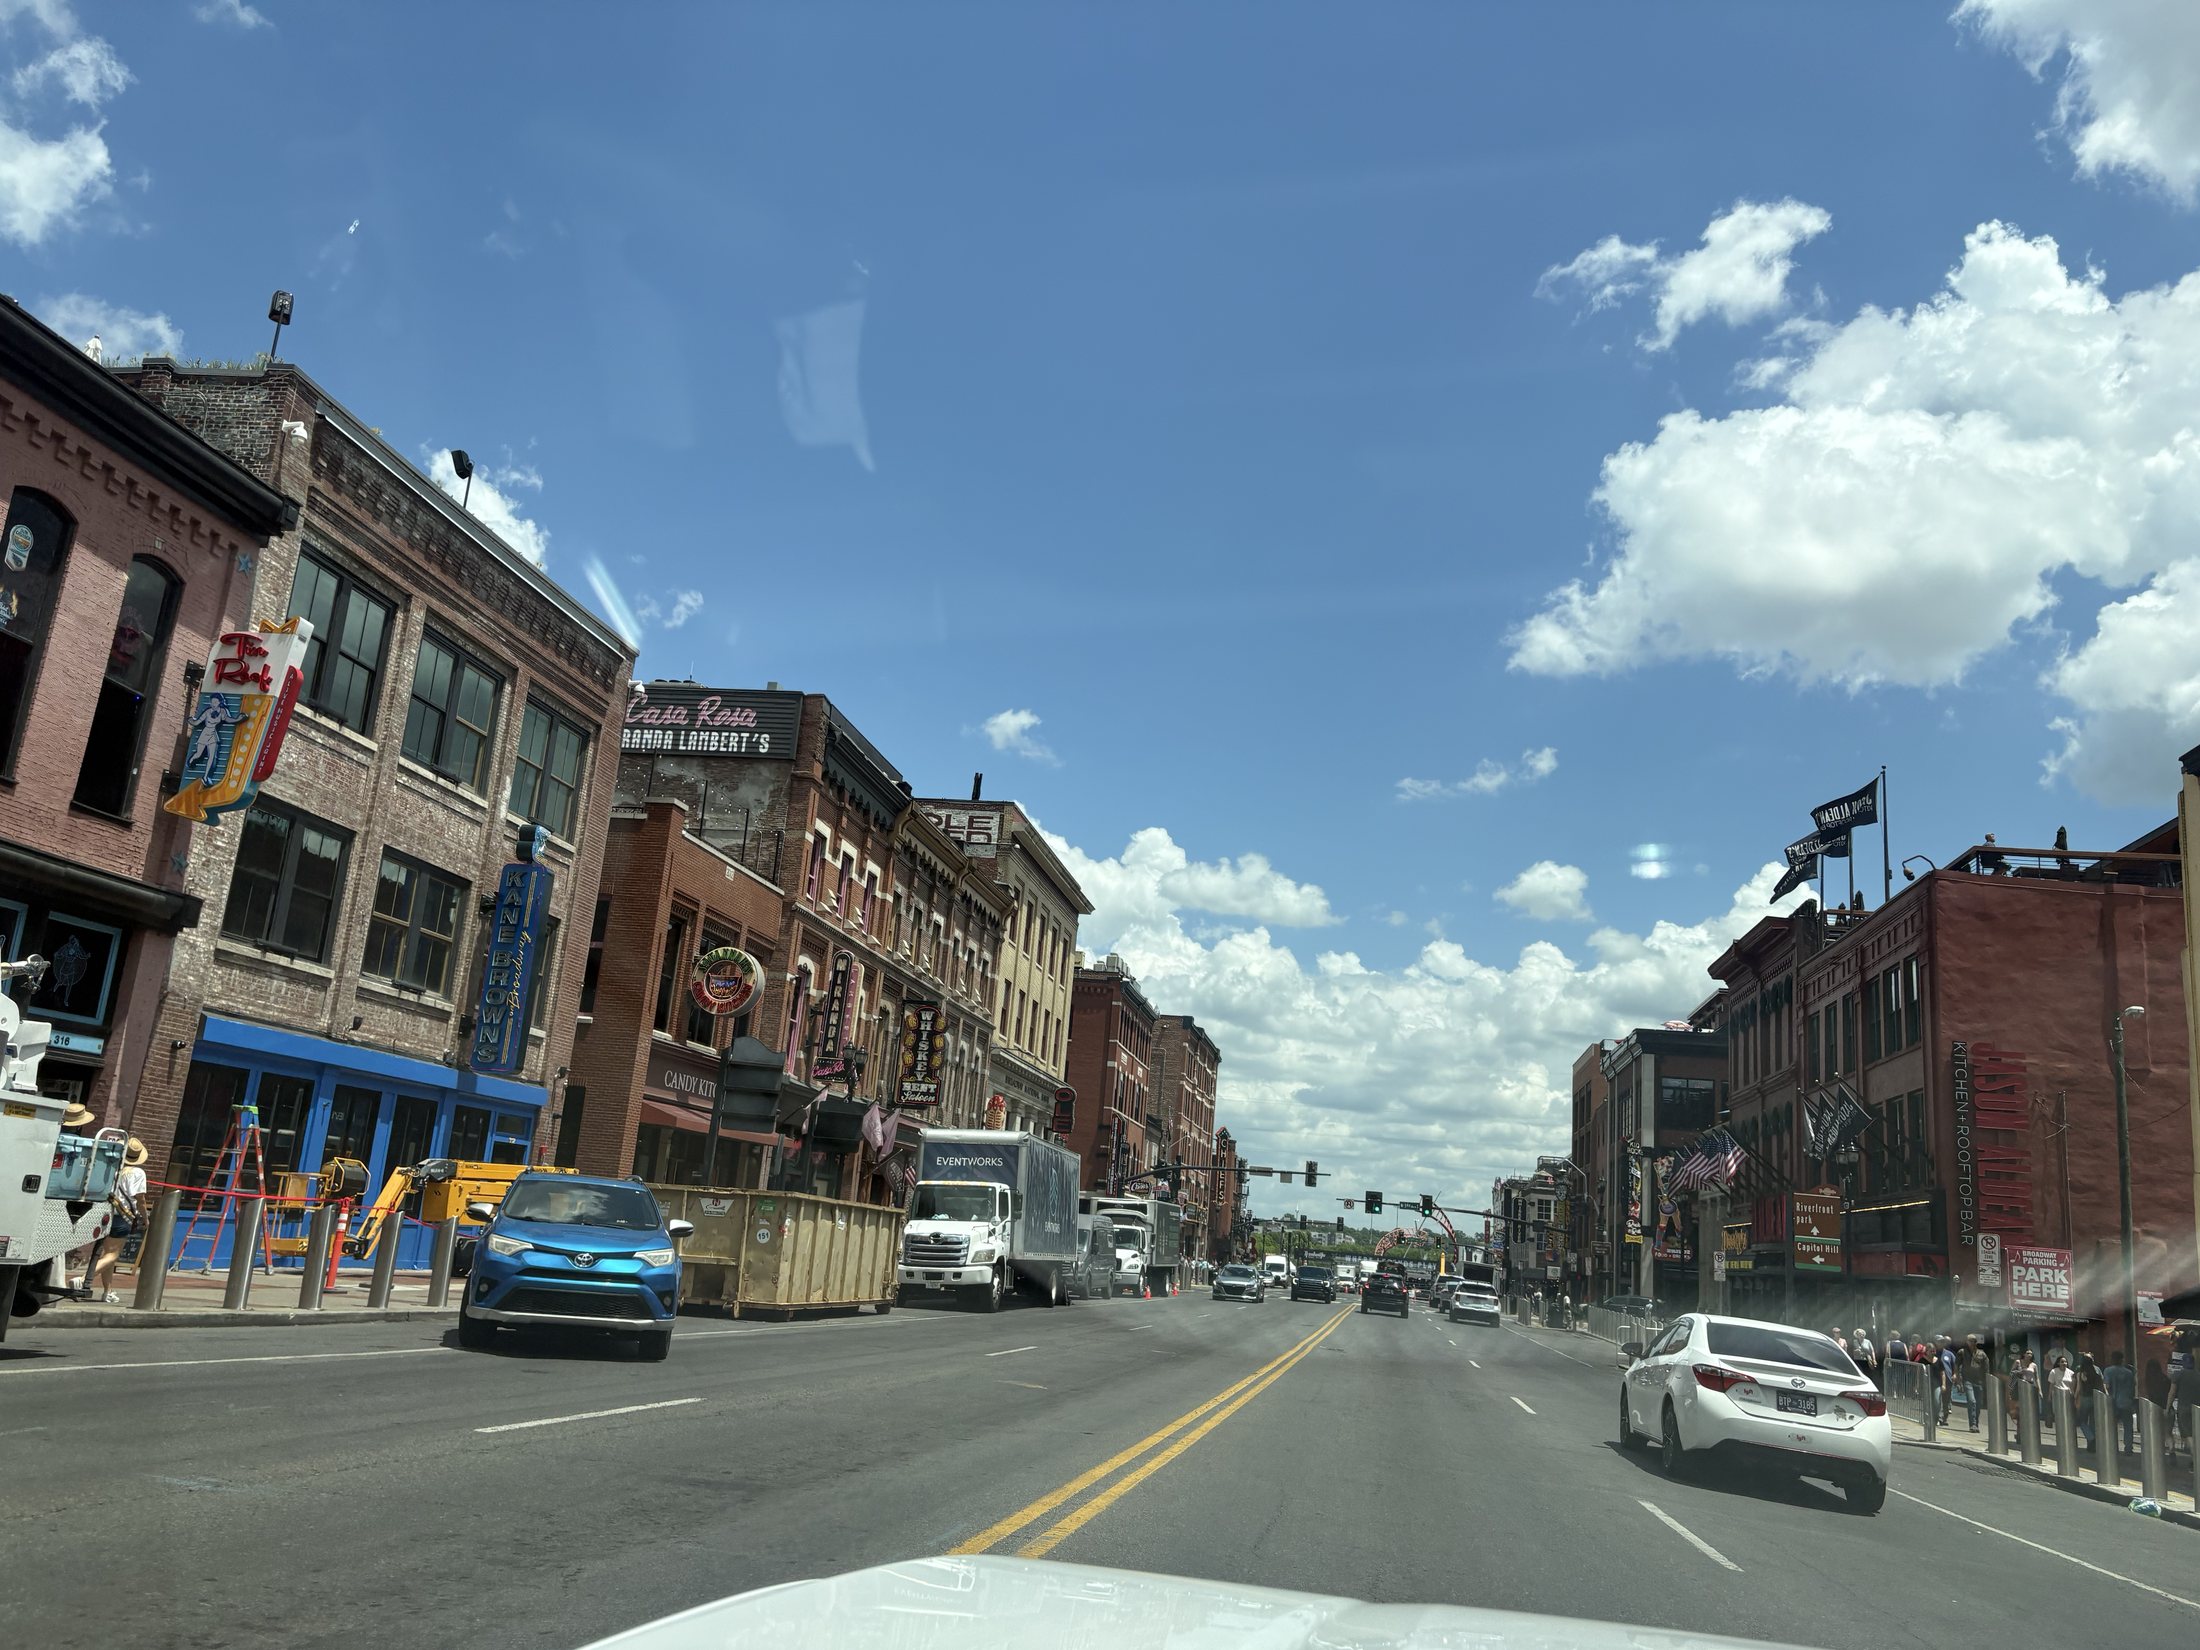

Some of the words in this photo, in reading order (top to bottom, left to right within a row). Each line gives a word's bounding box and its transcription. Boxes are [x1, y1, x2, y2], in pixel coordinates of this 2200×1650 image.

[220, 632, 269, 660] Tin
[213, 658, 273, 692] Roof
[625, 694, 689, 726] Casa
[694, 695, 758, 728] Rosa
[678, 730, 770, 753] LAMBERT'S
[499, 871, 527, 944] KANE
[475, 950, 513, 1064] BROWNS
[825, 957, 848, 1053] MIRANDA
[53, 1035, 70, 1046] 316
[917, 1010, 935, 1082] WHISKEY
[664, 1070, 698, 1093] CANDY
[902, 1082, 938, 1093] BENT
[1953, 1041, 1969, 1113] KITCHEN
[1971, 1042, 2030, 1130] JASON
[901, 1090, 936, 1103] Saloon
[936, 1156, 1004, 1167] EVENTWORKS
[1956, 1125, 1973, 1207] ROOFTOP
[1796, 1202, 1834, 1215] Riverfront
[1796, 1215, 1813, 1224] park
[1960, 1210, 1975, 1246] BAR
[758, 1231, 770, 1241] 151
[1797, 1242, 1823, 1254] Capitol
[1825, 1245, 1840, 1255] Hill
[2022, 1250, 2057, 1259] BROADWAY
[2022, 1257, 2058, 1267] PARKING
[2012, 1265, 2069, 1284] PARK
[2012, 1281, 2069, 1300] HERE
[1778, 1396, 1792, 1406] BTP
[1797, 1399, 1815, 1410] 3185
